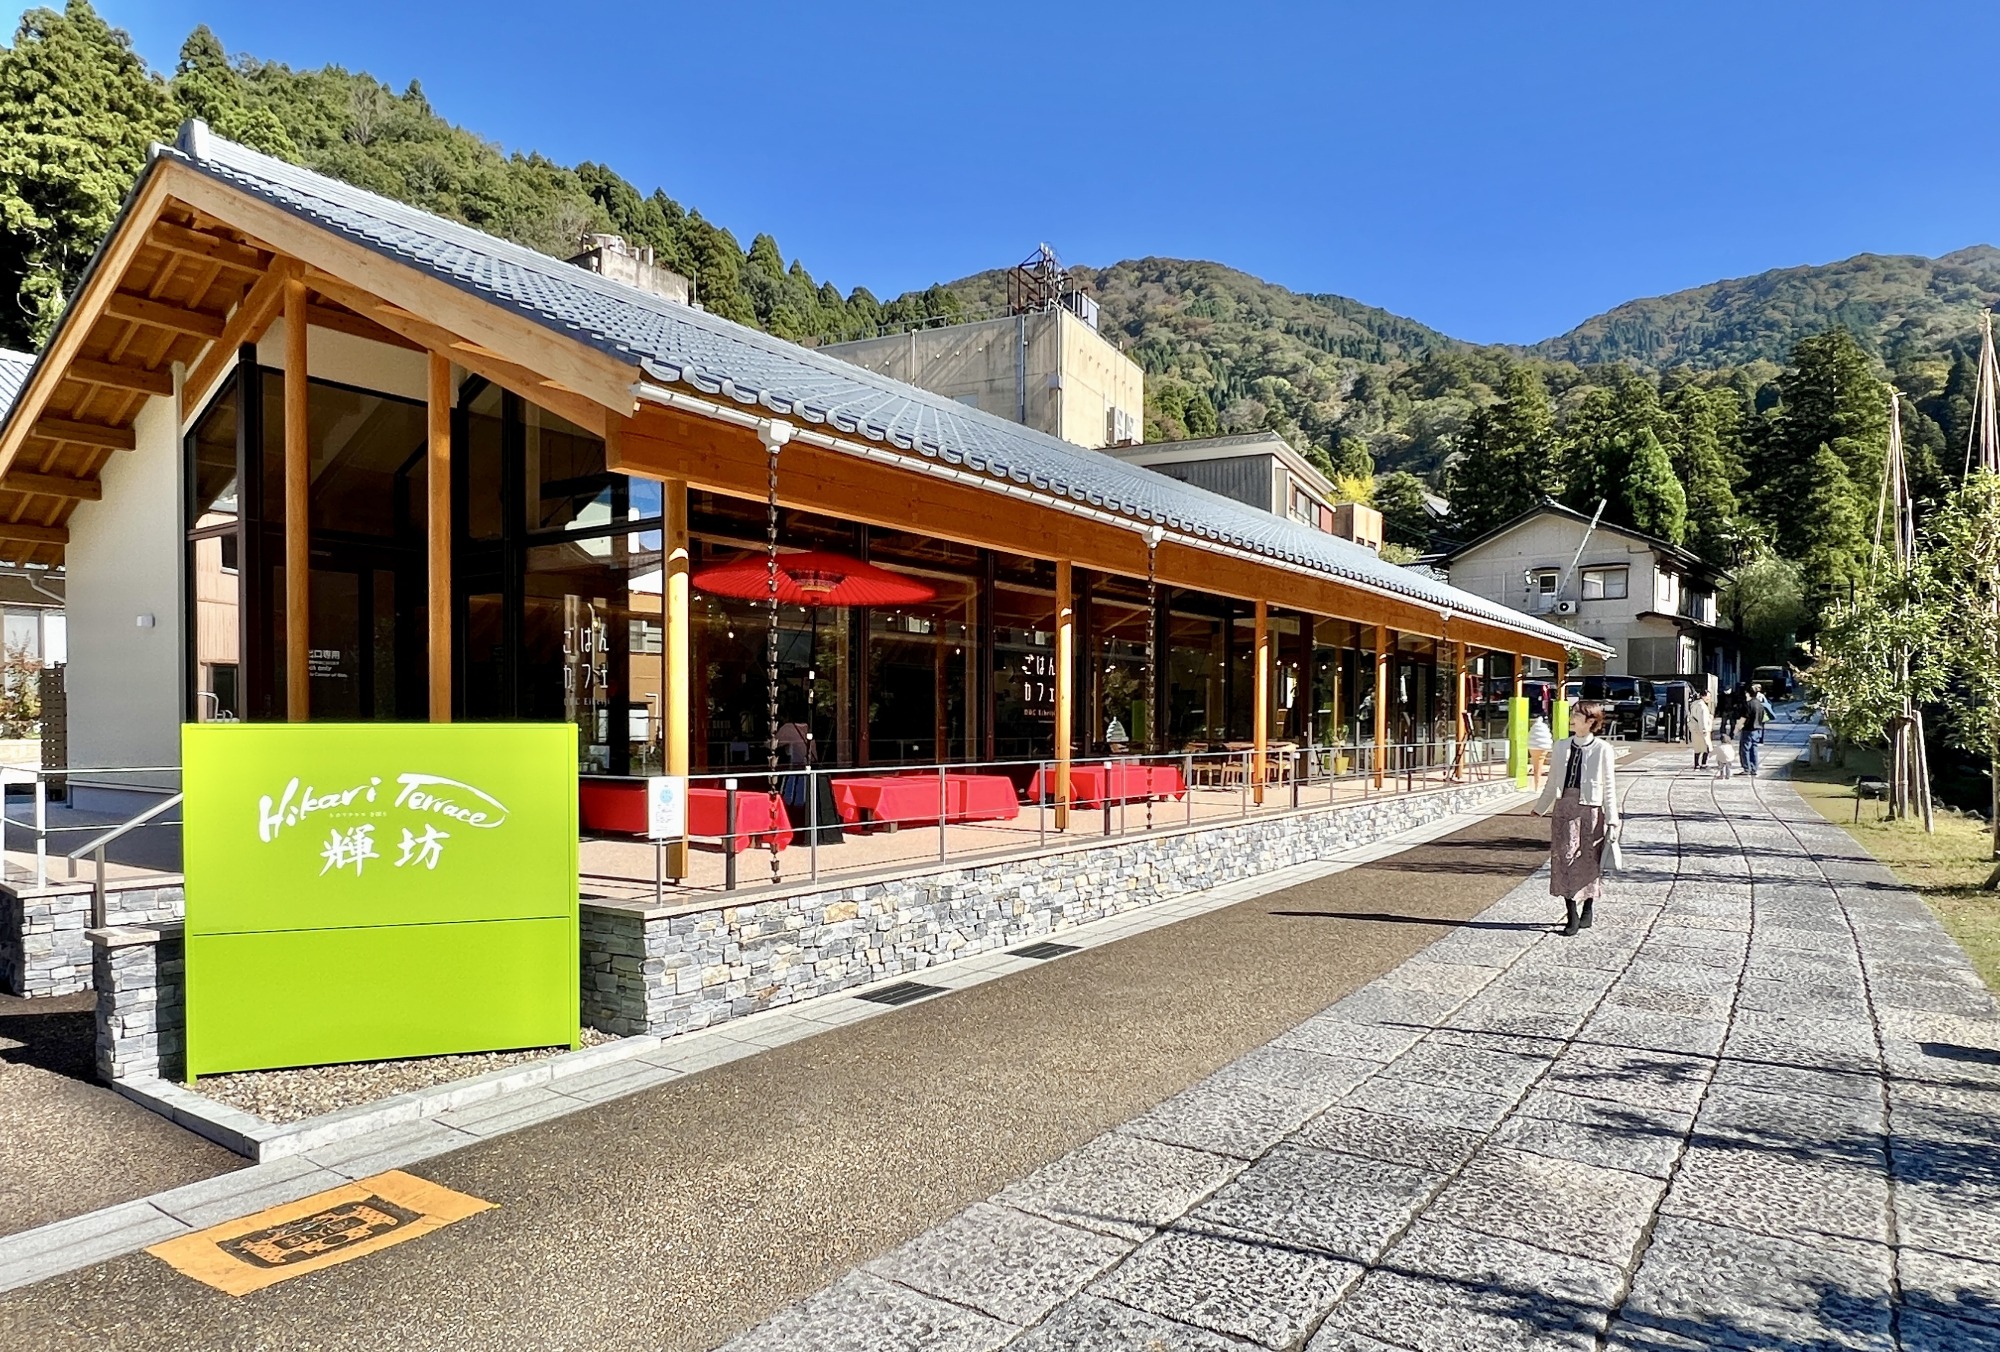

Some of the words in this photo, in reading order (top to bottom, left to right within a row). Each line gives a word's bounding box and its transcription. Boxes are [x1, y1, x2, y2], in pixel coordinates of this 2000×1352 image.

[563, 627, 609, 653] ごはん
[564, 664, 608, 688] カフェ
[1022, 654, 1055, 676] ごはん
[1024, 682, 1055, 703] カフェ
[259, 777, 382, 843] Hikari
[395, 773, 509, 828] Terrace
[319, 824, 450, 877] 輝坊
